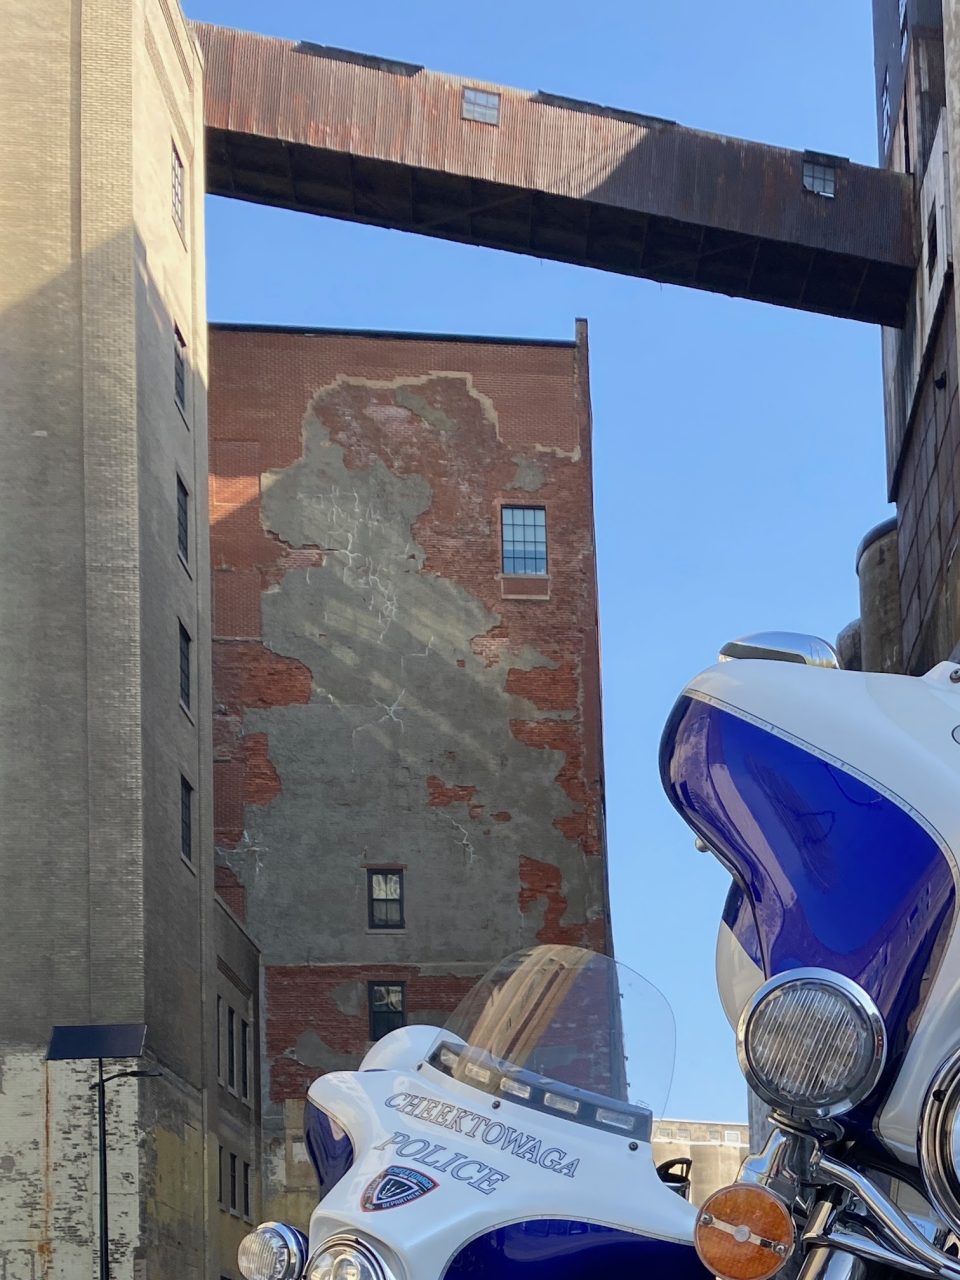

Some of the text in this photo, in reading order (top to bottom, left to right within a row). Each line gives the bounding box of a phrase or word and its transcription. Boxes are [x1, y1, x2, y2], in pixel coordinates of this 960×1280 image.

[374, 1131, 510, 1195] POLICE
[384, 1091, 582, 1179] CHEEKTOWAGA
[382, 1189, 424, 1208] DEPARTMENT
